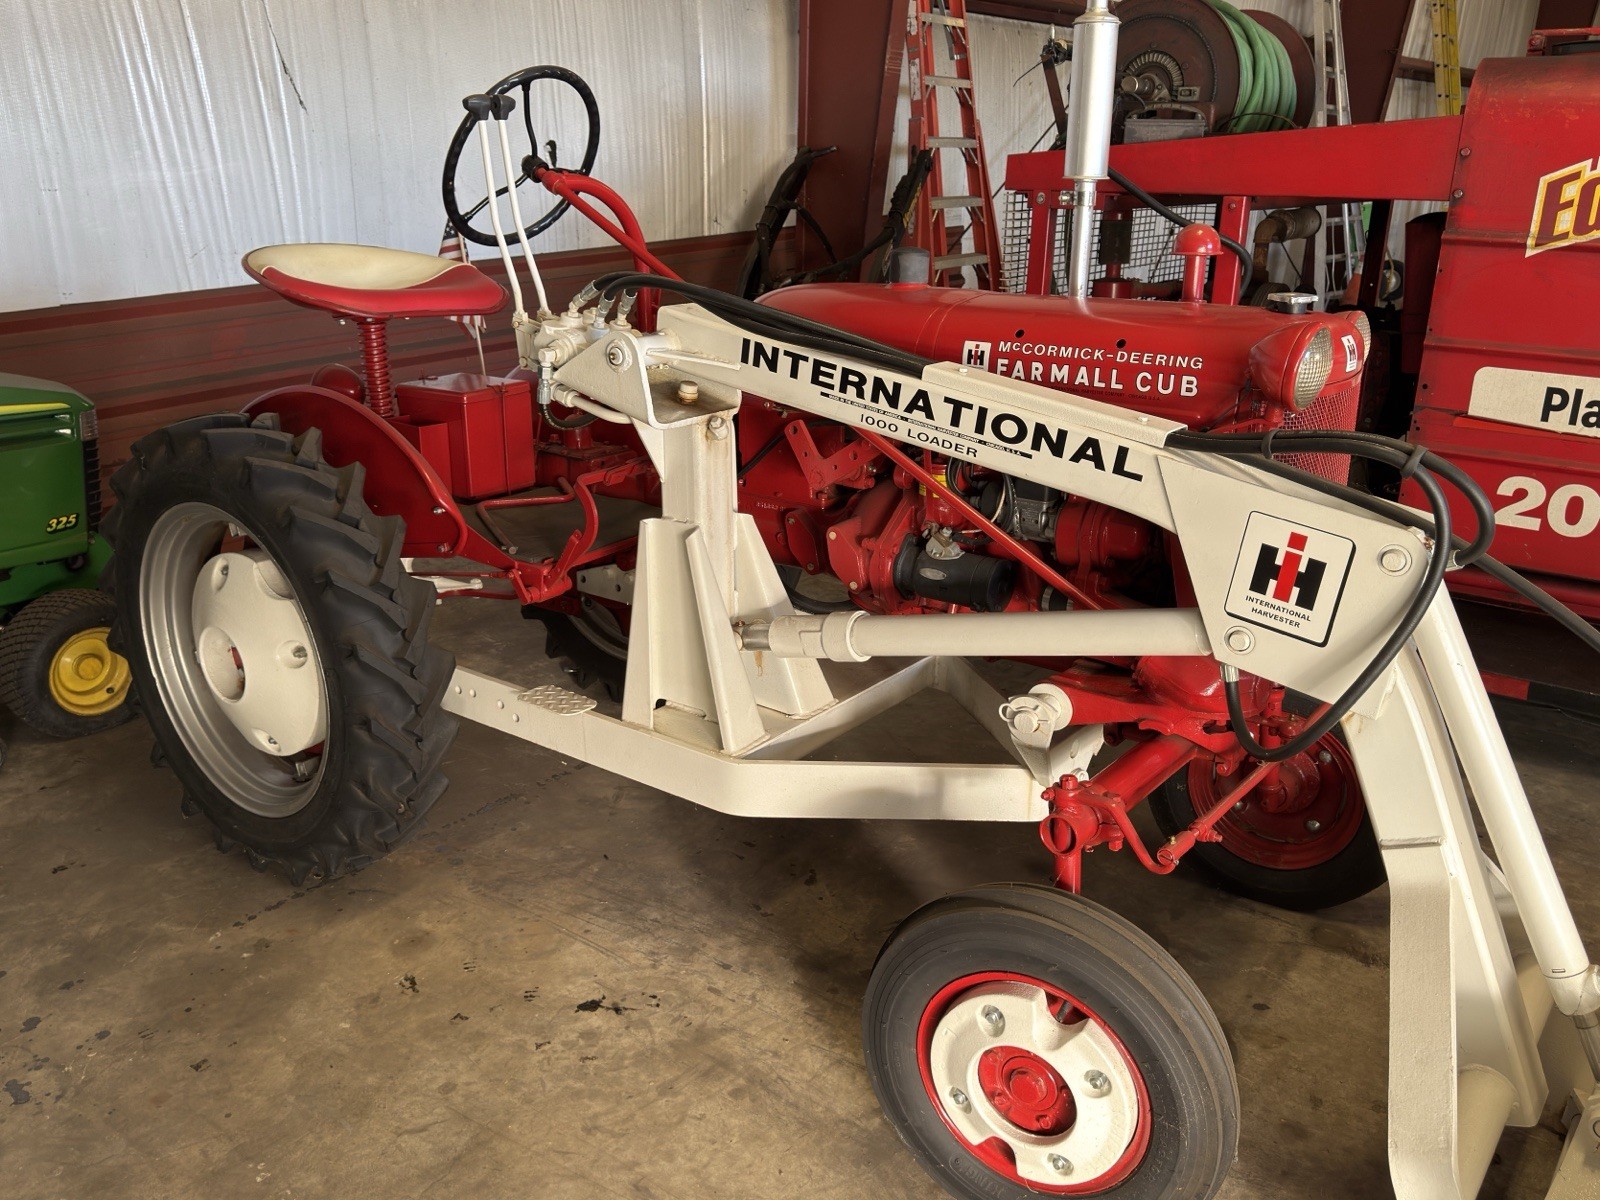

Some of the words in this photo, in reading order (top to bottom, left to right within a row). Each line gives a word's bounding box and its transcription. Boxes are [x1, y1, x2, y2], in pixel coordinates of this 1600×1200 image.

[998, 340, 1203, 369] McCORMICK-DEERING
[996, 358, 1124, 390] FARMALL
[1136, 371, 1198, 397] CUB
[740, 337, 1144, 483] INTERNATIONAL
[861, 413, 899, 433] 1000
[907, 428, 978, 458] LOADER
[46, 513, 78, 532] 325
[1245, 595, 1312, 622] INTERNATIONAL
[1251, 607, 1301, 628] HARVESTER
